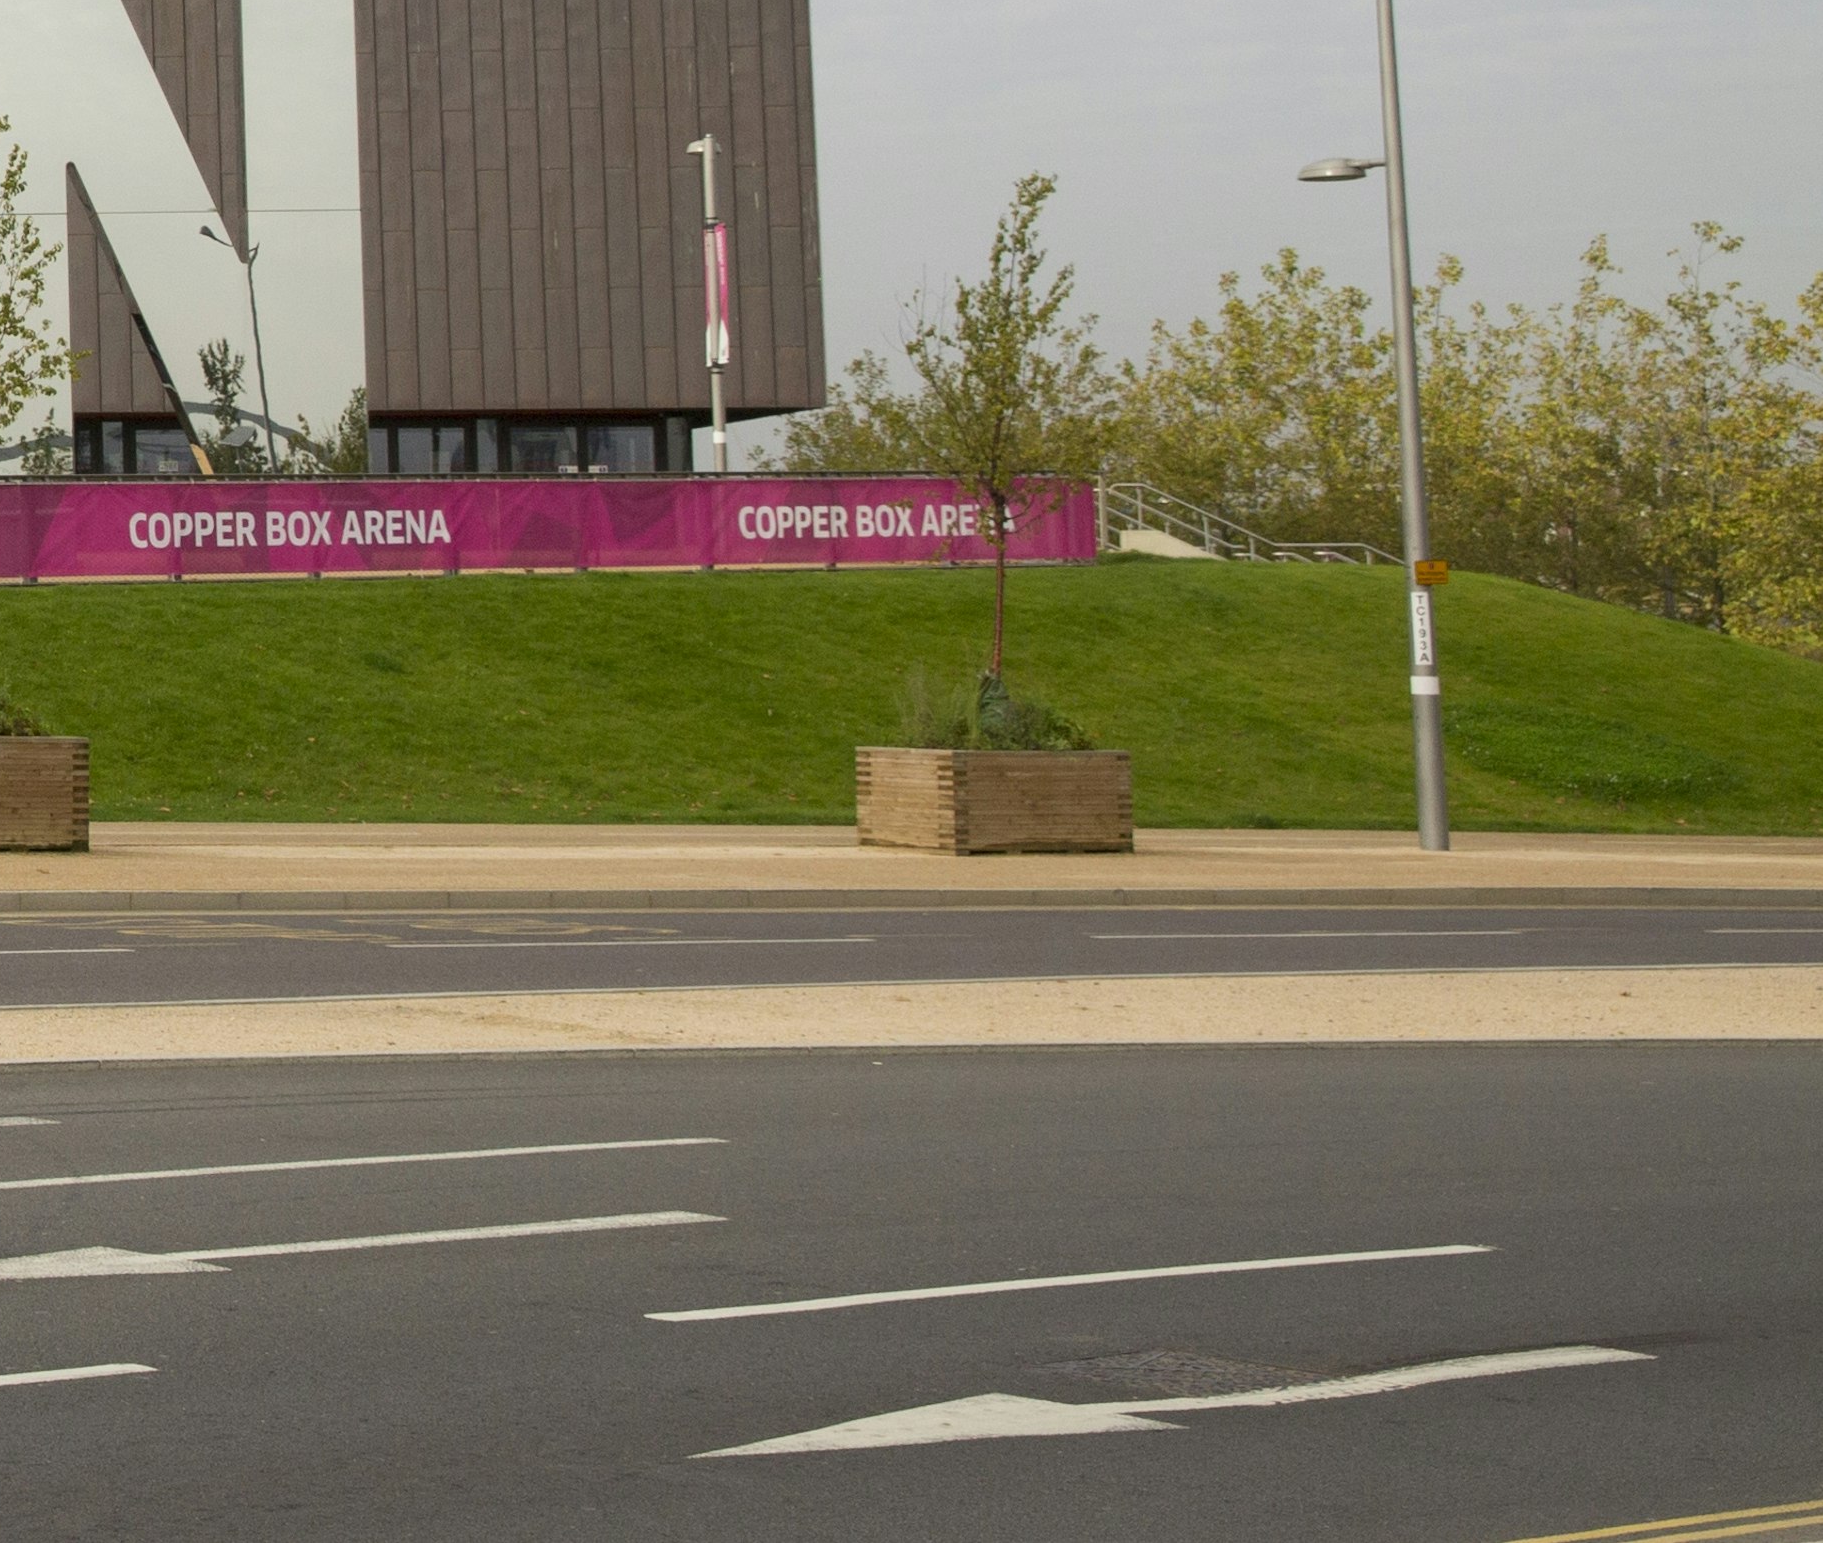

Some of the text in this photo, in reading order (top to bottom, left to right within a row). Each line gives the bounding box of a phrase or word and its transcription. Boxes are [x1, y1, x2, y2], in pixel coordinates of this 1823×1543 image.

[129, 510, 450, 548] COPPER BOX ARENA
[738, 506, 849, 539] COPPER
[856, 505, 915, 537] BOX
